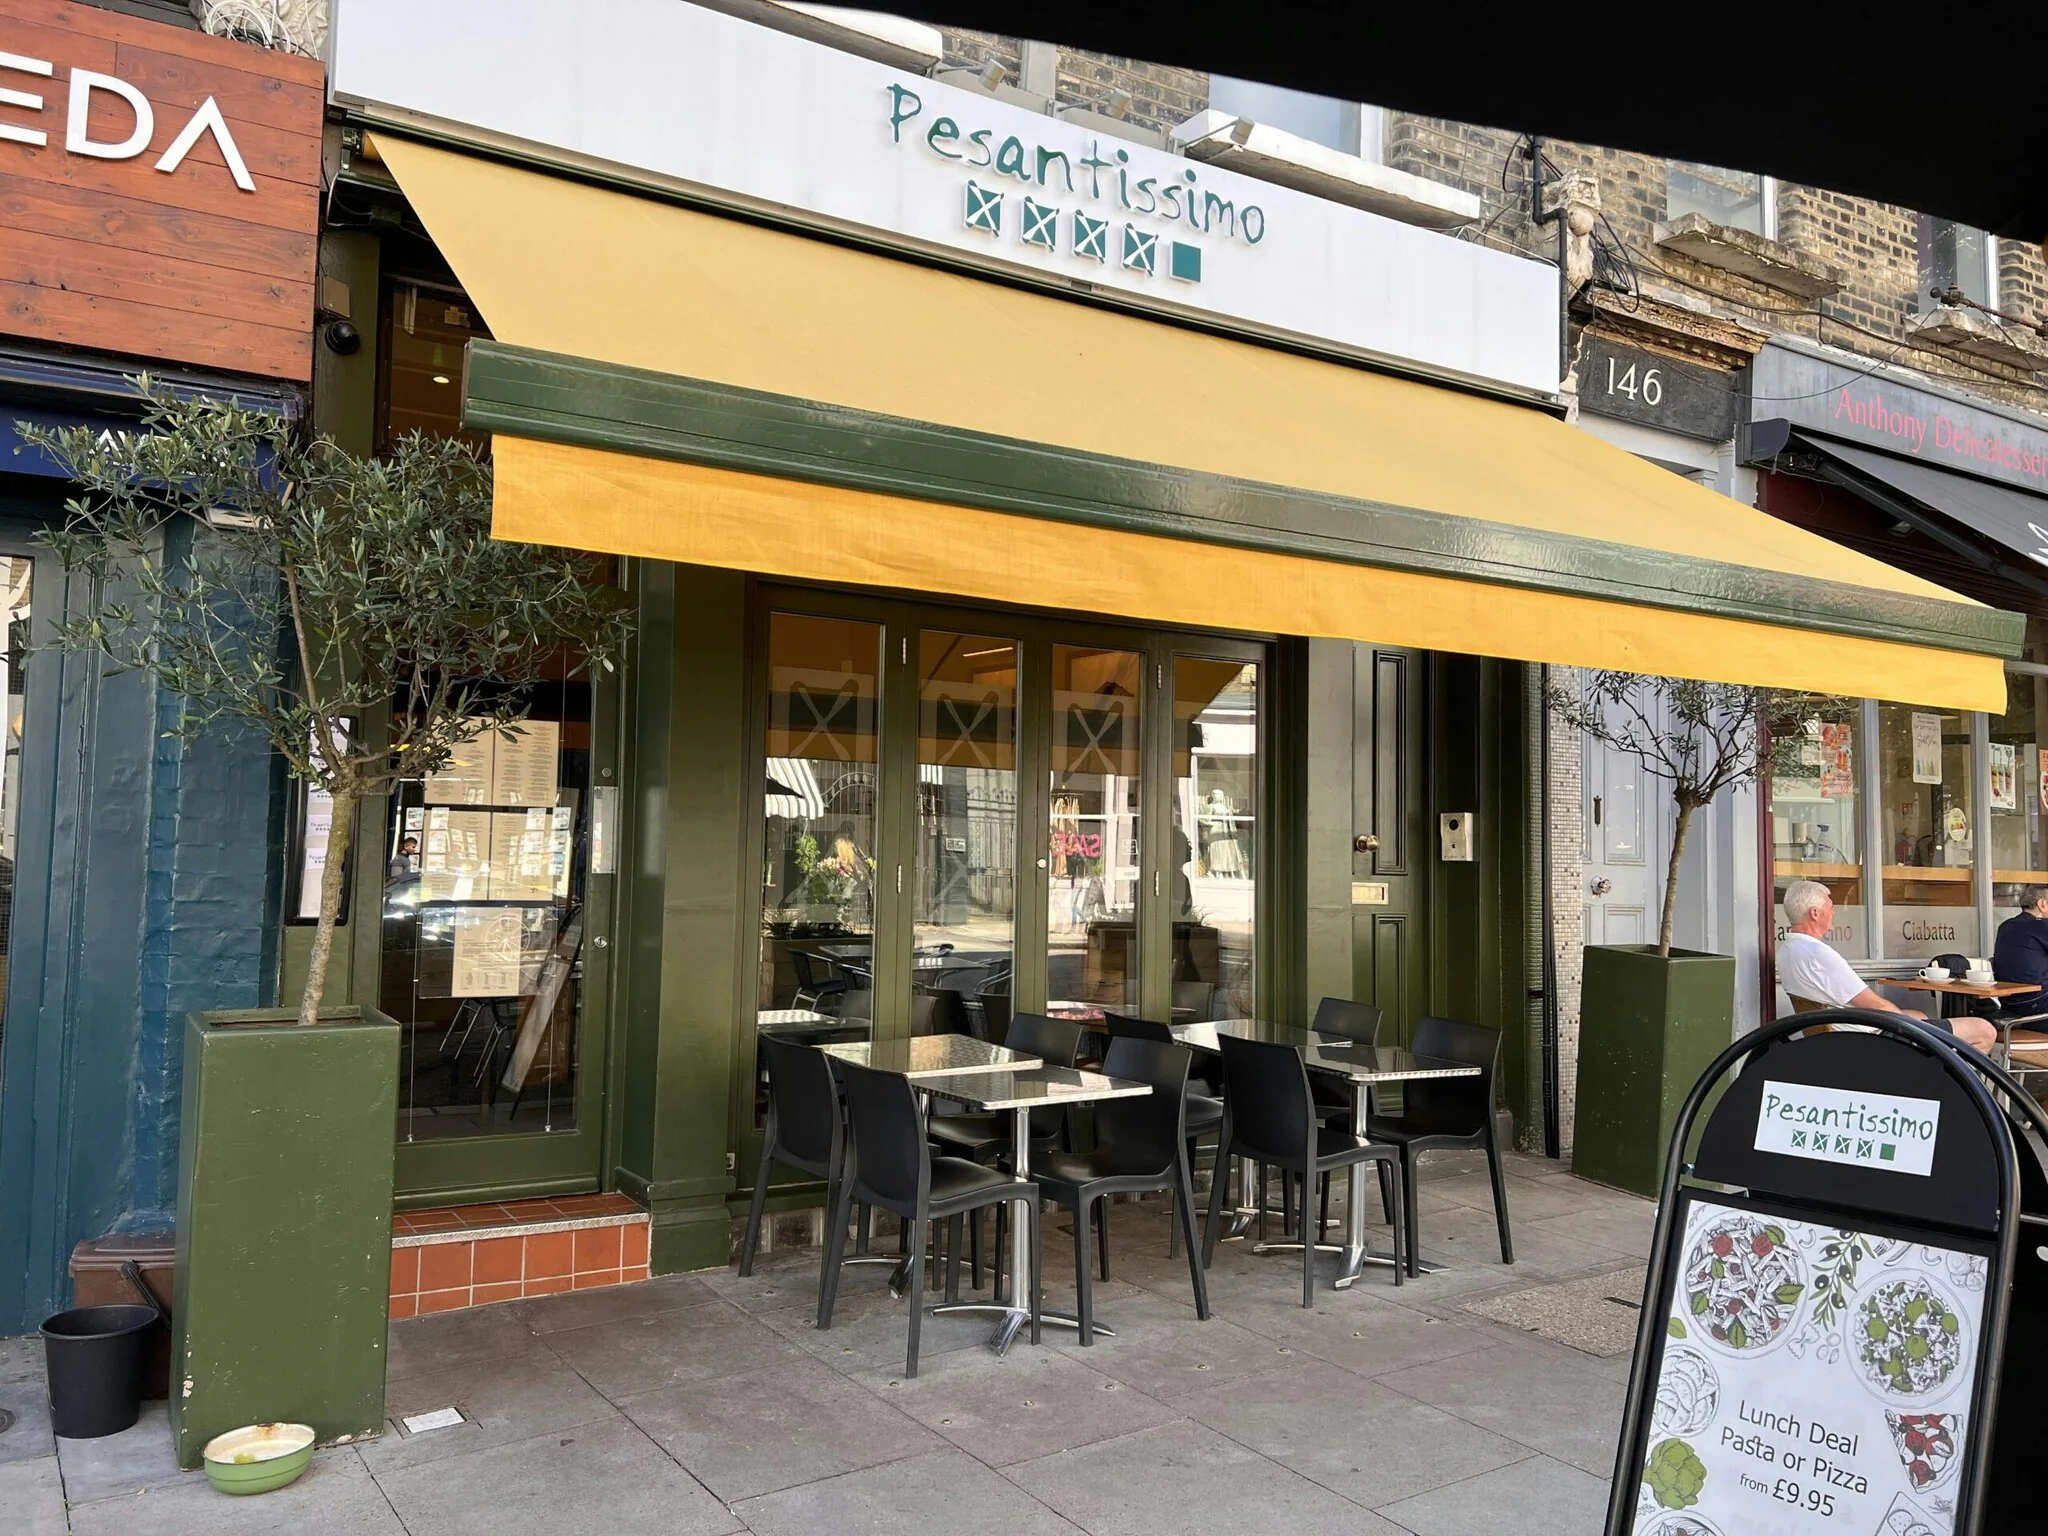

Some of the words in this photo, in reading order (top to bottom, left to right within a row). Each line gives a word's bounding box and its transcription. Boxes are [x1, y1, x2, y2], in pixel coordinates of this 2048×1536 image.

[887, 83, 1266, 244] Pesantissimo
[1606, 356, 1662, 406] 146
[1835, 387, 1927, 454] Anthony
[1902, 919, 1955, 941] Ciabatta
[1766, 1094, 1933, 1140] Pesantissimo
[1739, 1400, 1800, 1438] Lunch
[1809, 1422, 1858, 1456] Deal
[1721, 1426, 1775, 1462] Pasta
[1783, 1452, 1806, 1472] or
[1813, 1457, 1868, 1494] Pizza
[1740, 1473, 1768, 1494] from
[1772, 1478, 1836, 1516] £9.95
